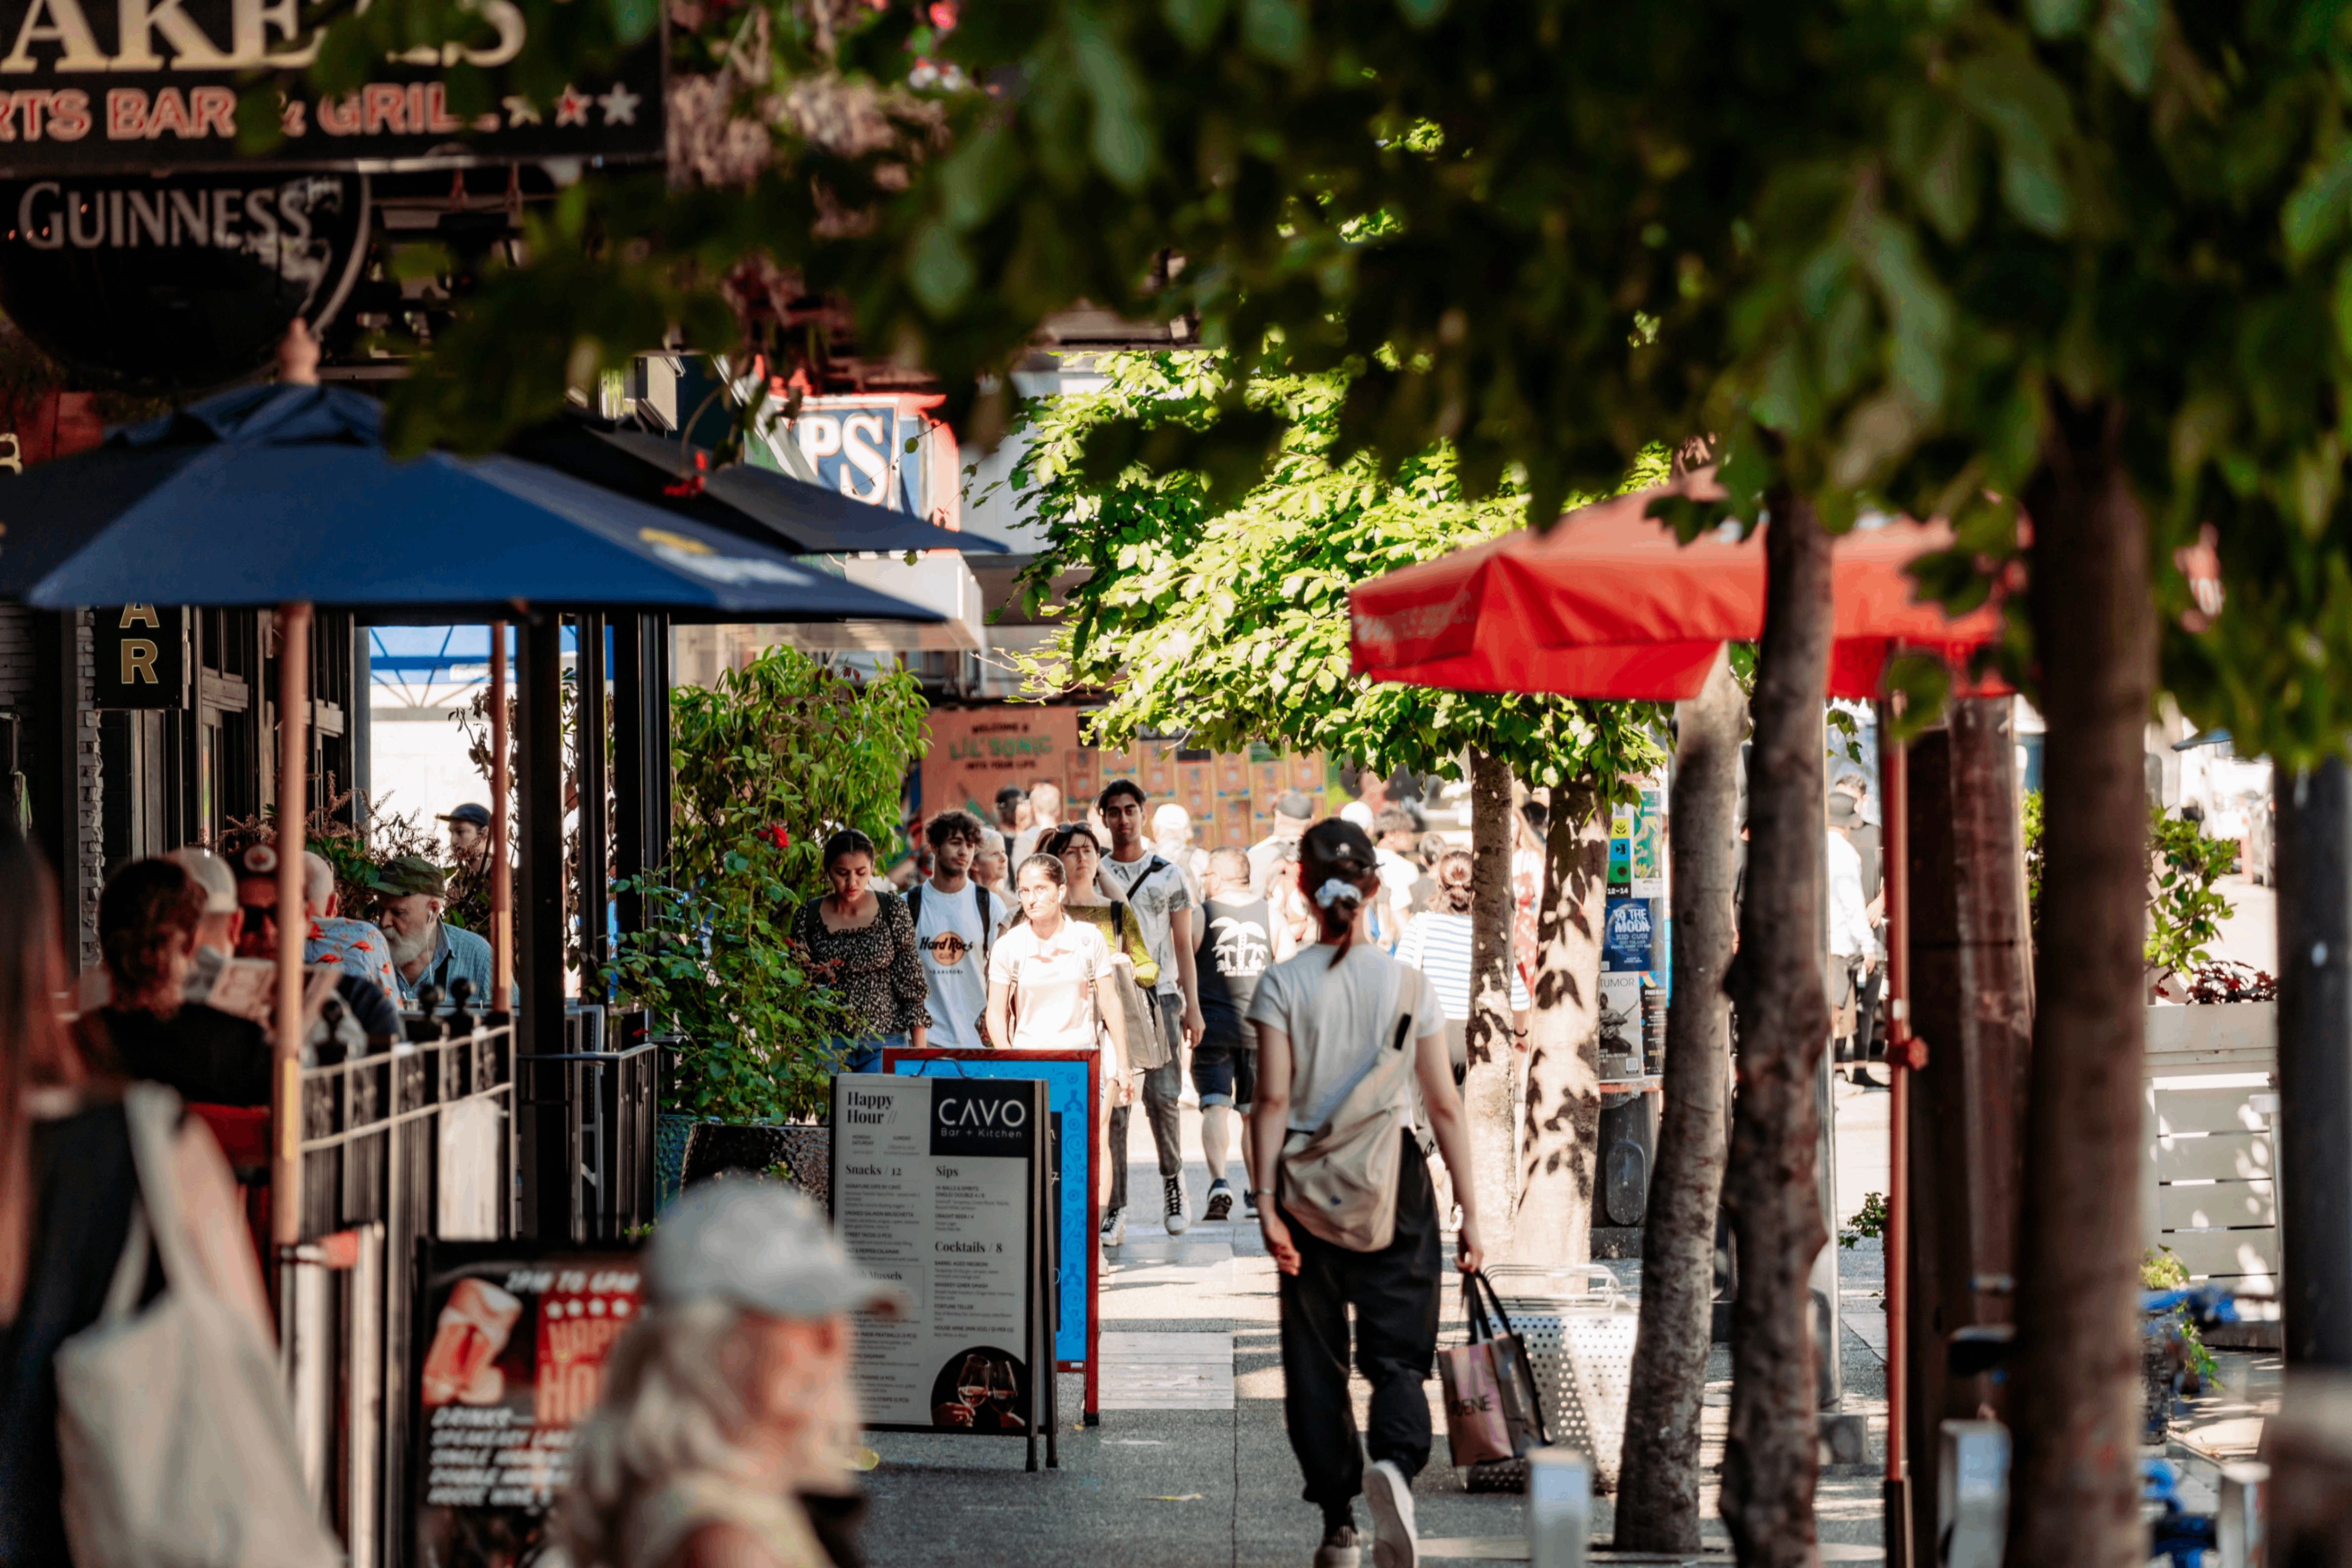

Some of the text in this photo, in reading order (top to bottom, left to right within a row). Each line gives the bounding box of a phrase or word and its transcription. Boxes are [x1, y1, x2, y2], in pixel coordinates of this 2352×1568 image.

[0, 0, 525, 73] AKES
[106, 86, 237, 140] BAR
[316, 82, 500, 137] GRIL
[18, 181, 312, 248] GUINNESS
[1613, 909, 1647, 920] TO THE
[1615, 919, 1650, 933] MOON
[919, 937, 948, 950] Hard
[1600, 977, 1634, 988] TUMOR
[848, 1091, 894, 1109] Happy
[847, 1109, 884, 1124] Hour
[939, 1098, 1026, 1127] CAVO
[941, 1128, 959, 1136] Bar
[978, 1128, 1022, 1137] Kitchen
[845, 1164, 882, 1175] Snacks
[936, 1165, 958, 1178] Sips
[935, 1241, 985, 1253] Cocktails
[996, 1243, 1002, 1253] 8
[870, 1271, 902, 1279] Mussels
